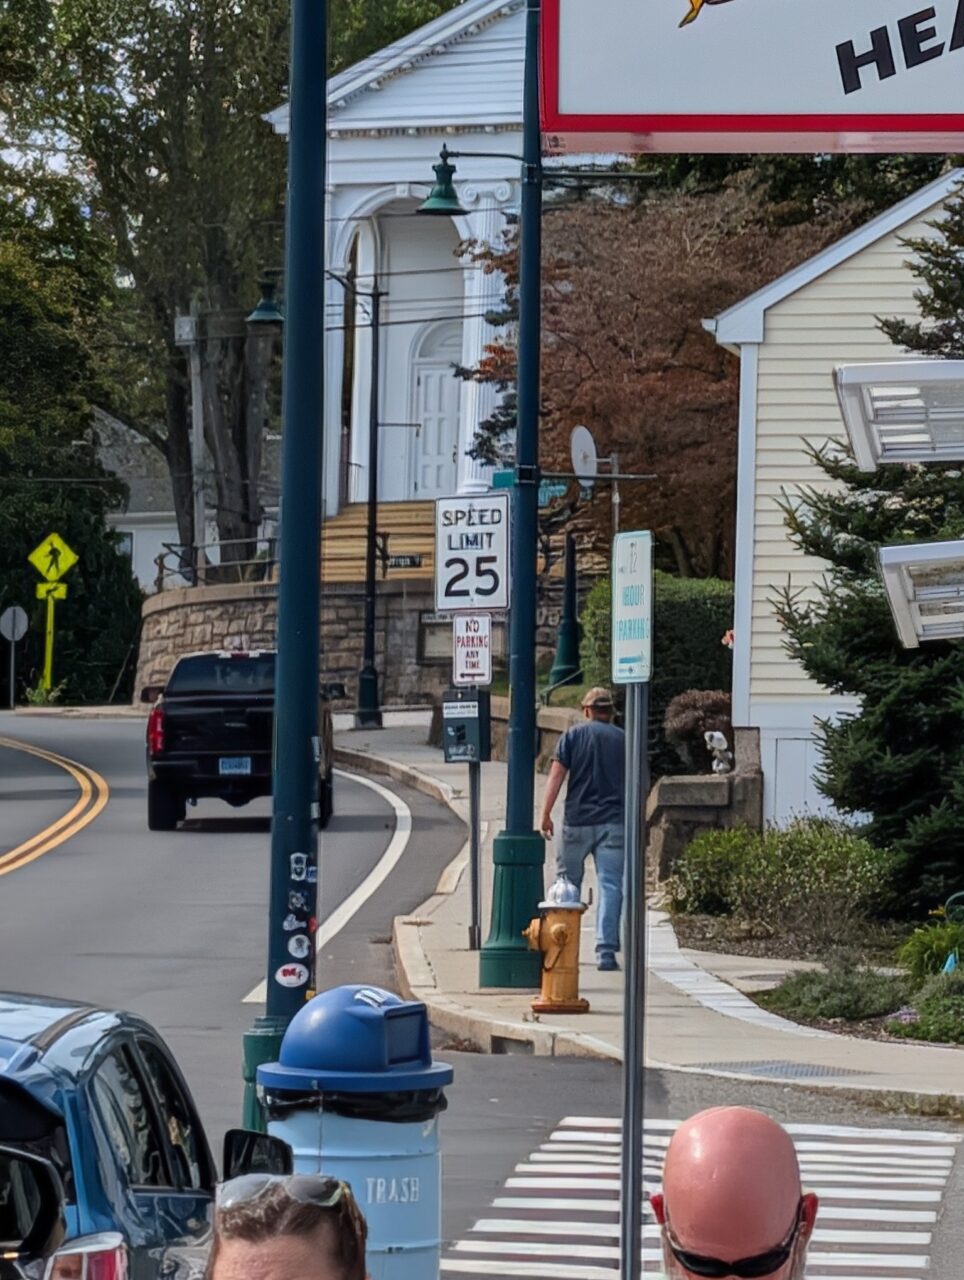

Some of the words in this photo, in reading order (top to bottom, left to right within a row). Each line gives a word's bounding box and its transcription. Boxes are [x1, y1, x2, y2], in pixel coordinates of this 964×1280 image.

[442, 508, 502, 527] SPEED
[447, 532, 496, 551] LIMIT
[444, 556, 500, 597] 25
[622, 583, 645, 606] HOUR
[465, 620, 480, 633] NO
[456, 635, 489, 648] PARKING
[465, 650, 479, 659] ANY
[465, 660, 480, 669] TIME
[366, 1177, 420, 1203] TRASH
